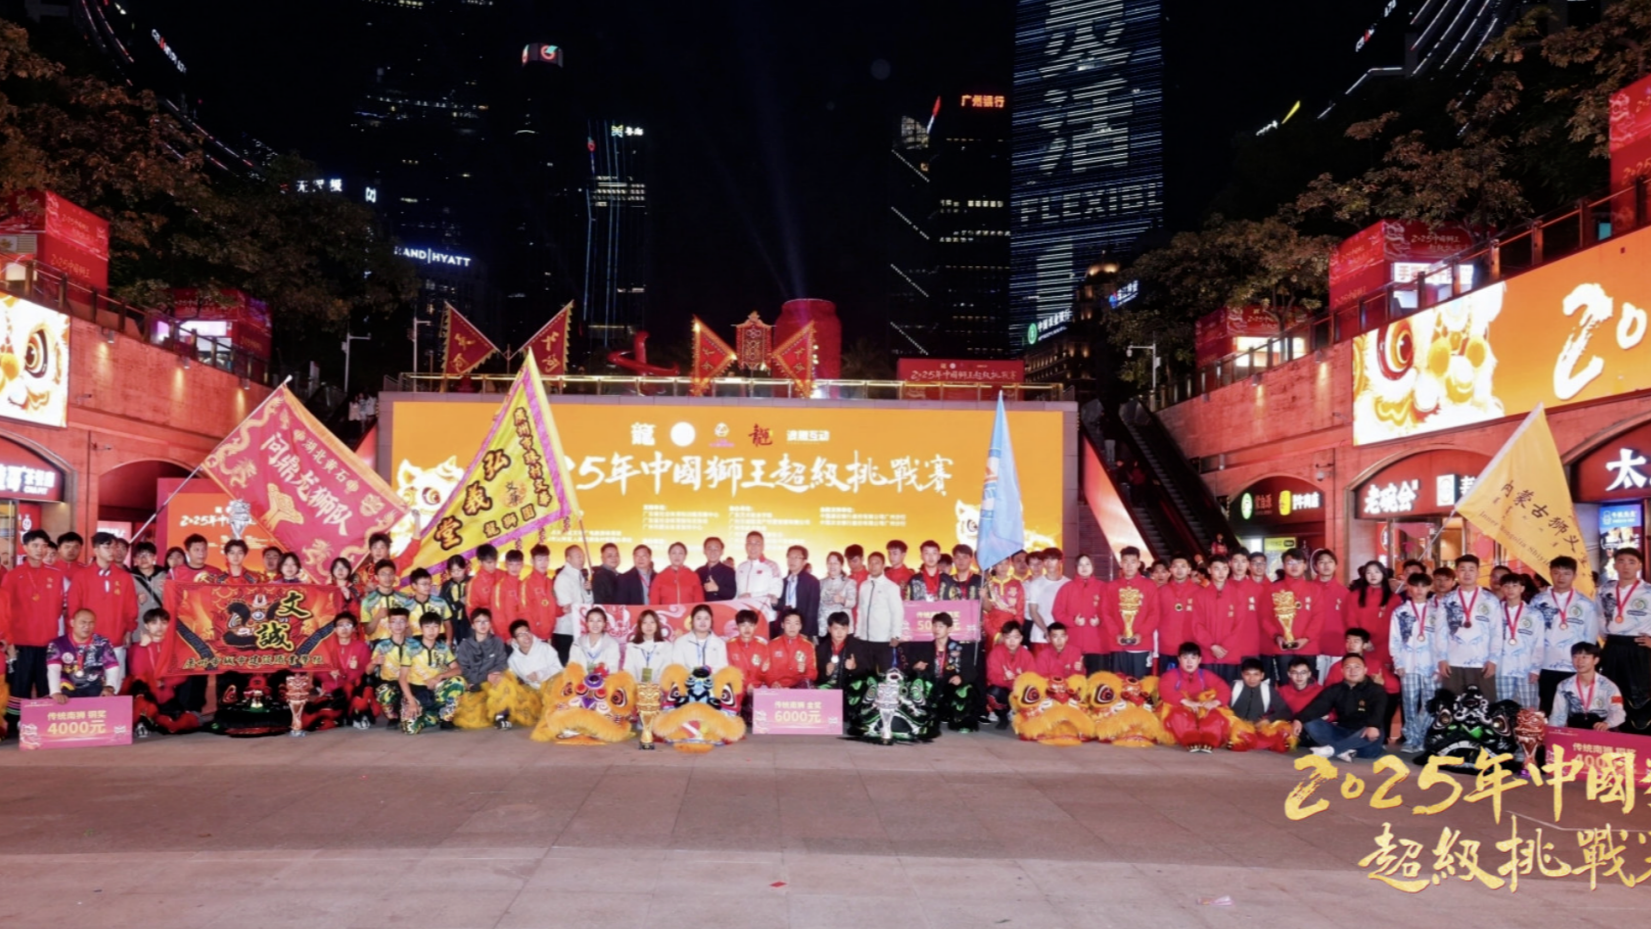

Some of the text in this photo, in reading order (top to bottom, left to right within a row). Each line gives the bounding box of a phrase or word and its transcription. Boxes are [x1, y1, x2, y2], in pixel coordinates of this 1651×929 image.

[961, 94, 1005, 108] 广州银行
[432, 252, 471, 267] HYATT
[302, 439, 349, 482] 湖北黄石
[564, 450, 954, 497] 5年中國獅王超級挑戰賽
[260, 432, 353, 536] 问鼎龙狮队
[1364, 480, 1418, 514] 老碗会
[255, 589, 312, 651] 文誠
[47, 719, 107, 735] 4000元
[774, 710, 822, 723] 6000元
